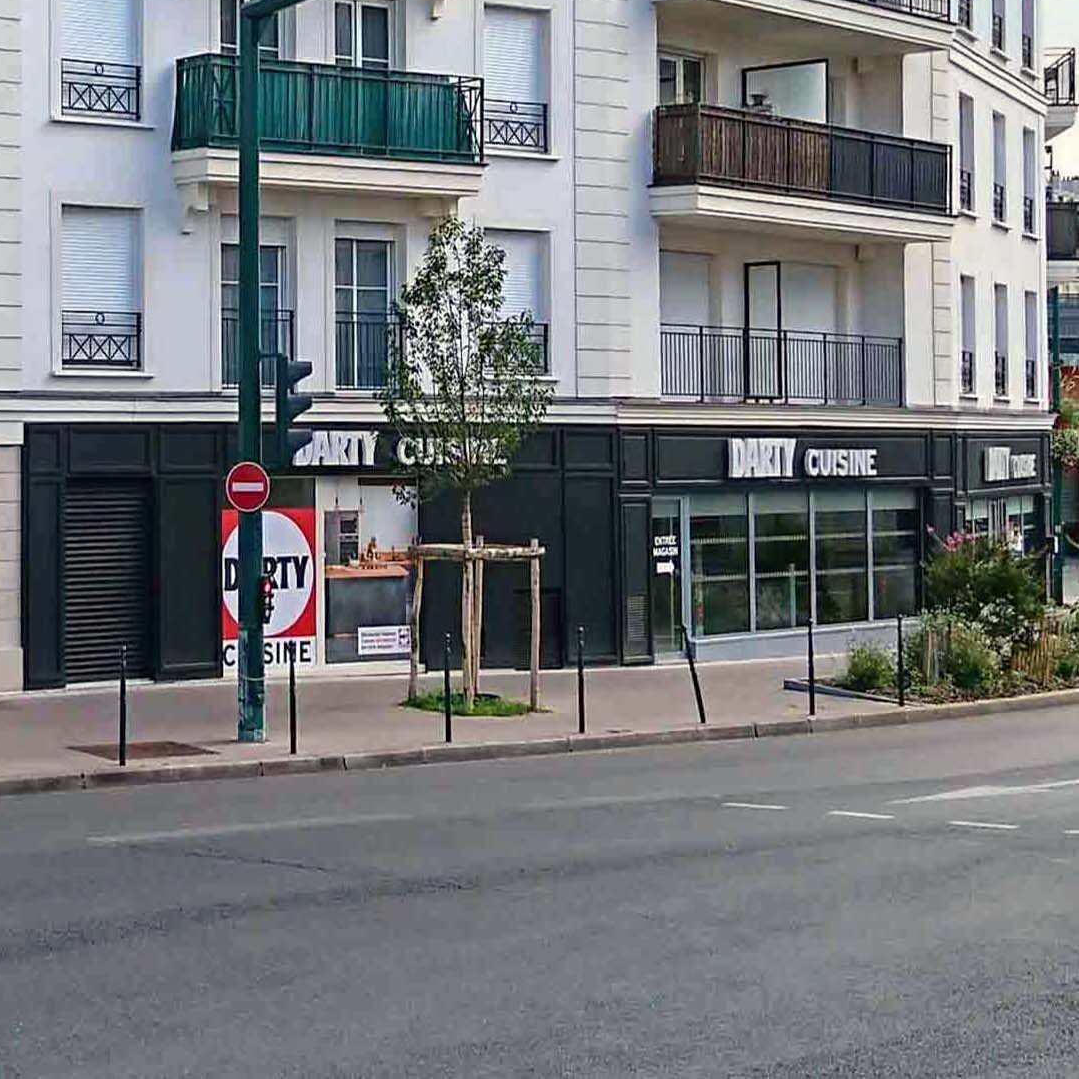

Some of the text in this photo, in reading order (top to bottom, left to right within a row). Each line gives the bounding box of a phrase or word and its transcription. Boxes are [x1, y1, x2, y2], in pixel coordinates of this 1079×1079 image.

[728, 437, 877, 478] DARTY CUISINE
[224, 555, 309, 591] DRTY
[224, 641, 312, 667] CSINE
